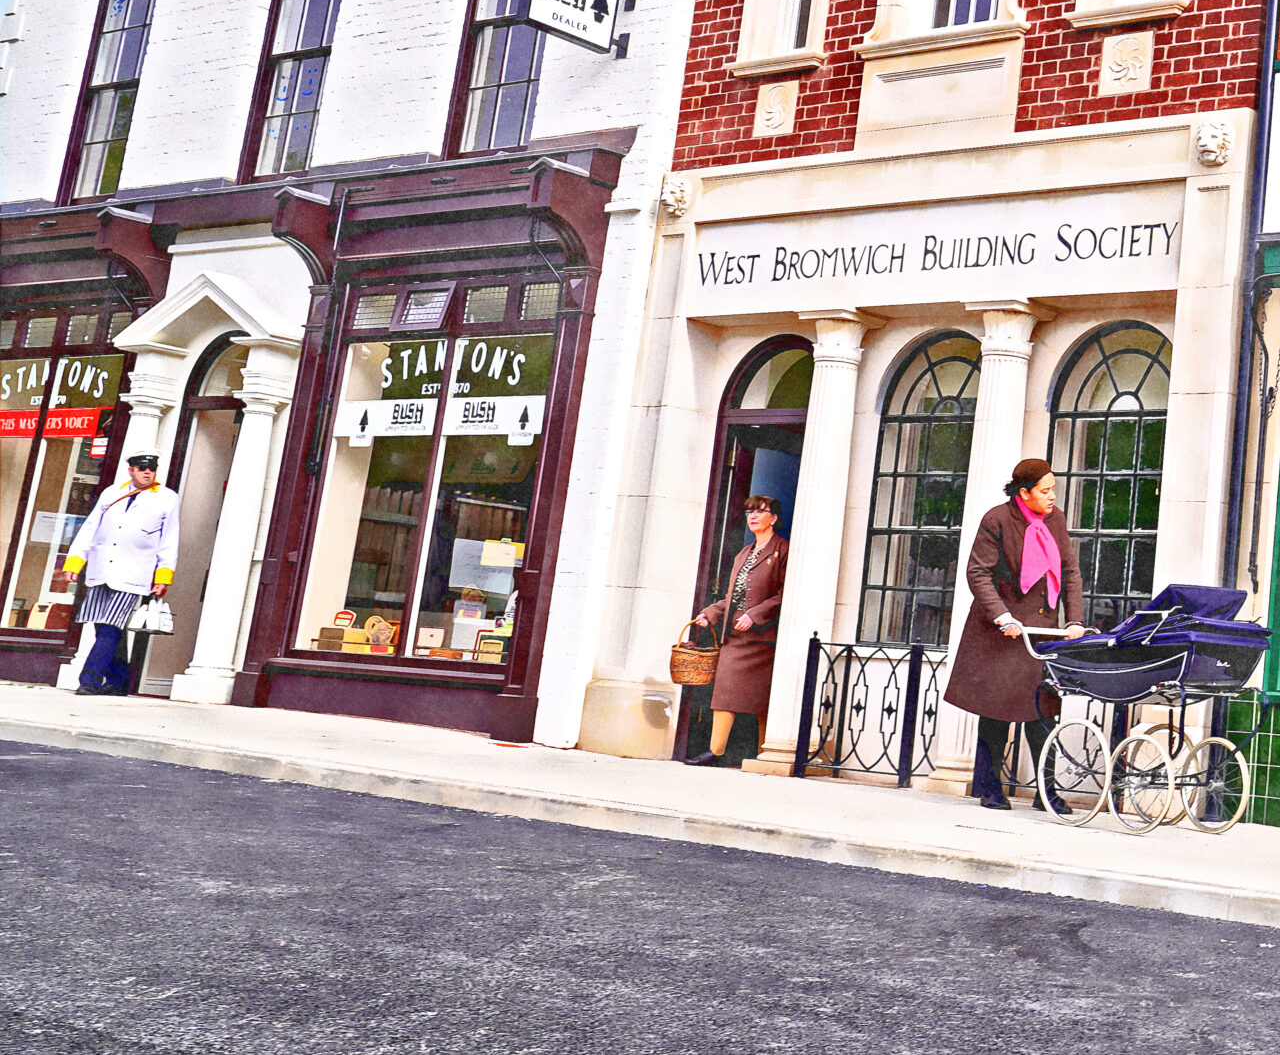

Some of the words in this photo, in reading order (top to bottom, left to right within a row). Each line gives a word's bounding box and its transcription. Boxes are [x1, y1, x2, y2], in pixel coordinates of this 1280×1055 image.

[552, 12, 588, 33] DEALER
[698, 251, 760, 286] WEST
[771, 243, 906, 282] BROMWICH
[921, 233, 1036, 271] BUILDING
[1055, 222, 1179, 262] SOCIETY
[391, 403, 424, 424] BUSH
[461, 401, 496, 423] BUSH
